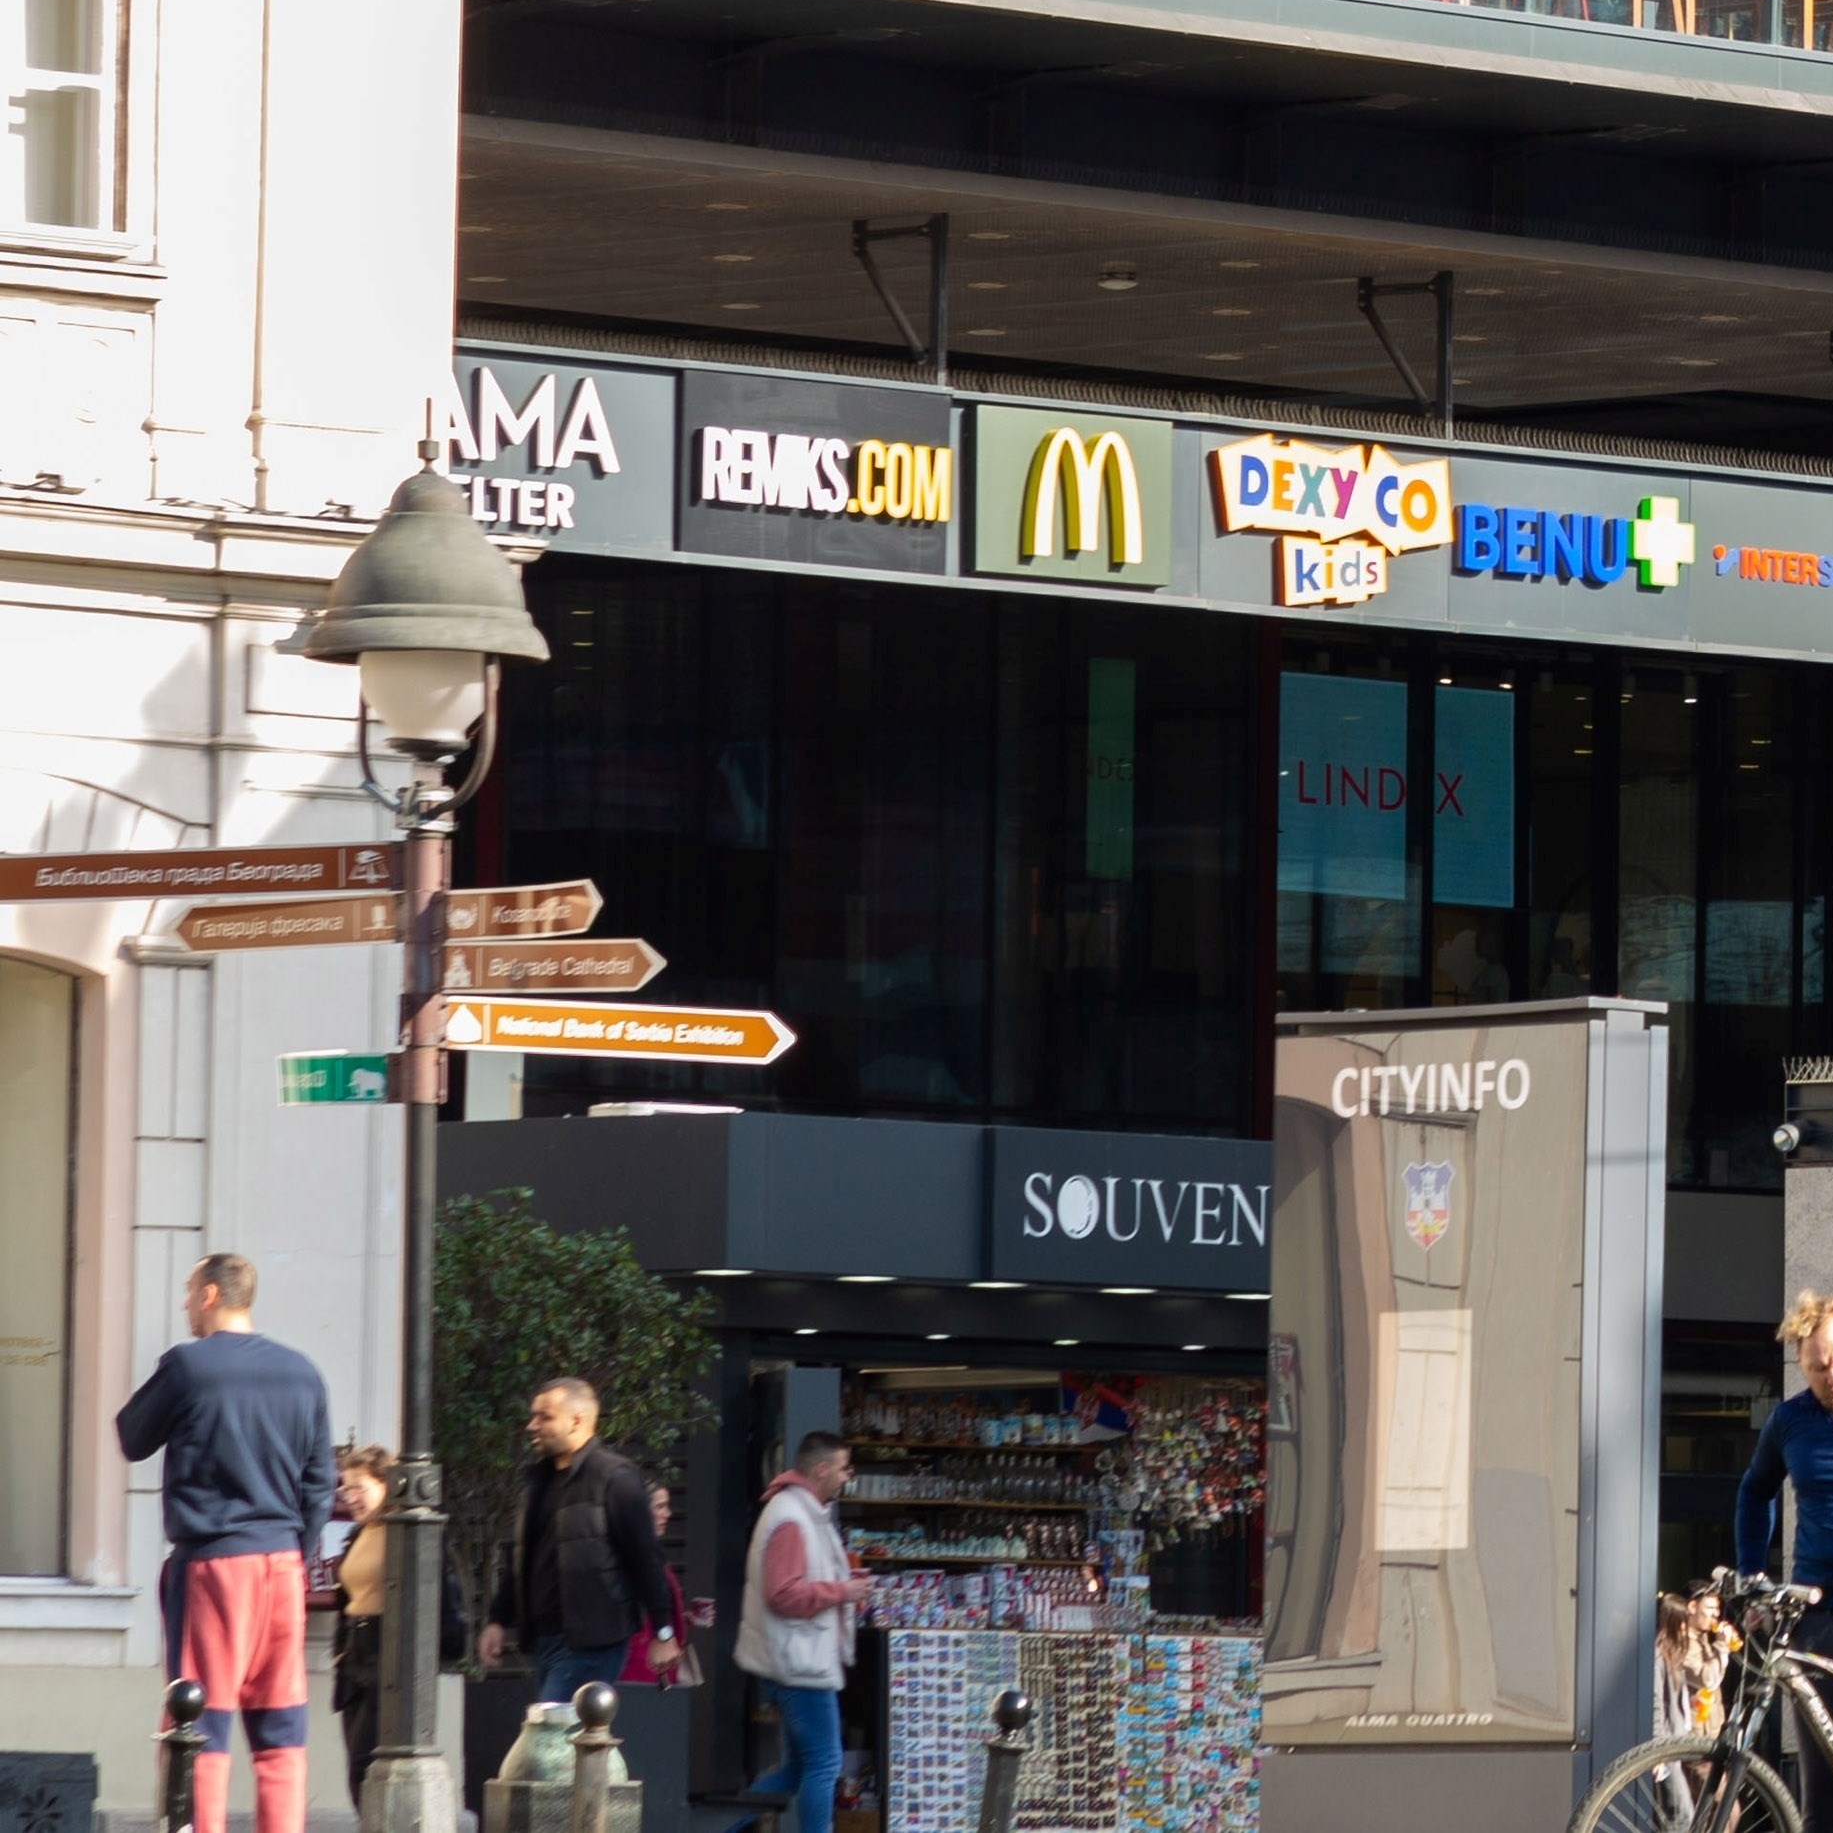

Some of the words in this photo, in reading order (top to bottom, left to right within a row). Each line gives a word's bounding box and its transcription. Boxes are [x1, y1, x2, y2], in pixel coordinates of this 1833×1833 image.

[1238, 451, 1358, 522] DEXY
[1374, 473, 1438, 534] CO
[1459, 503, 1628, 586] BENU
[1293, 549, 1380, 596] kids
[1295, 760, 1465, 817] LINDX
[488, 957, 558, 981] Belgrade
[560, 955, 636, 976] Cathedral
[496, 1015, 563, 1038] National
[564, 1017, 604, 1039] Bank
[1332, 1058, 1532, 1119] CITYINFO
[1344, 1714, 1399, 1728] ALMA
[1404, 1713, 1494, 1728] QUATTRO
